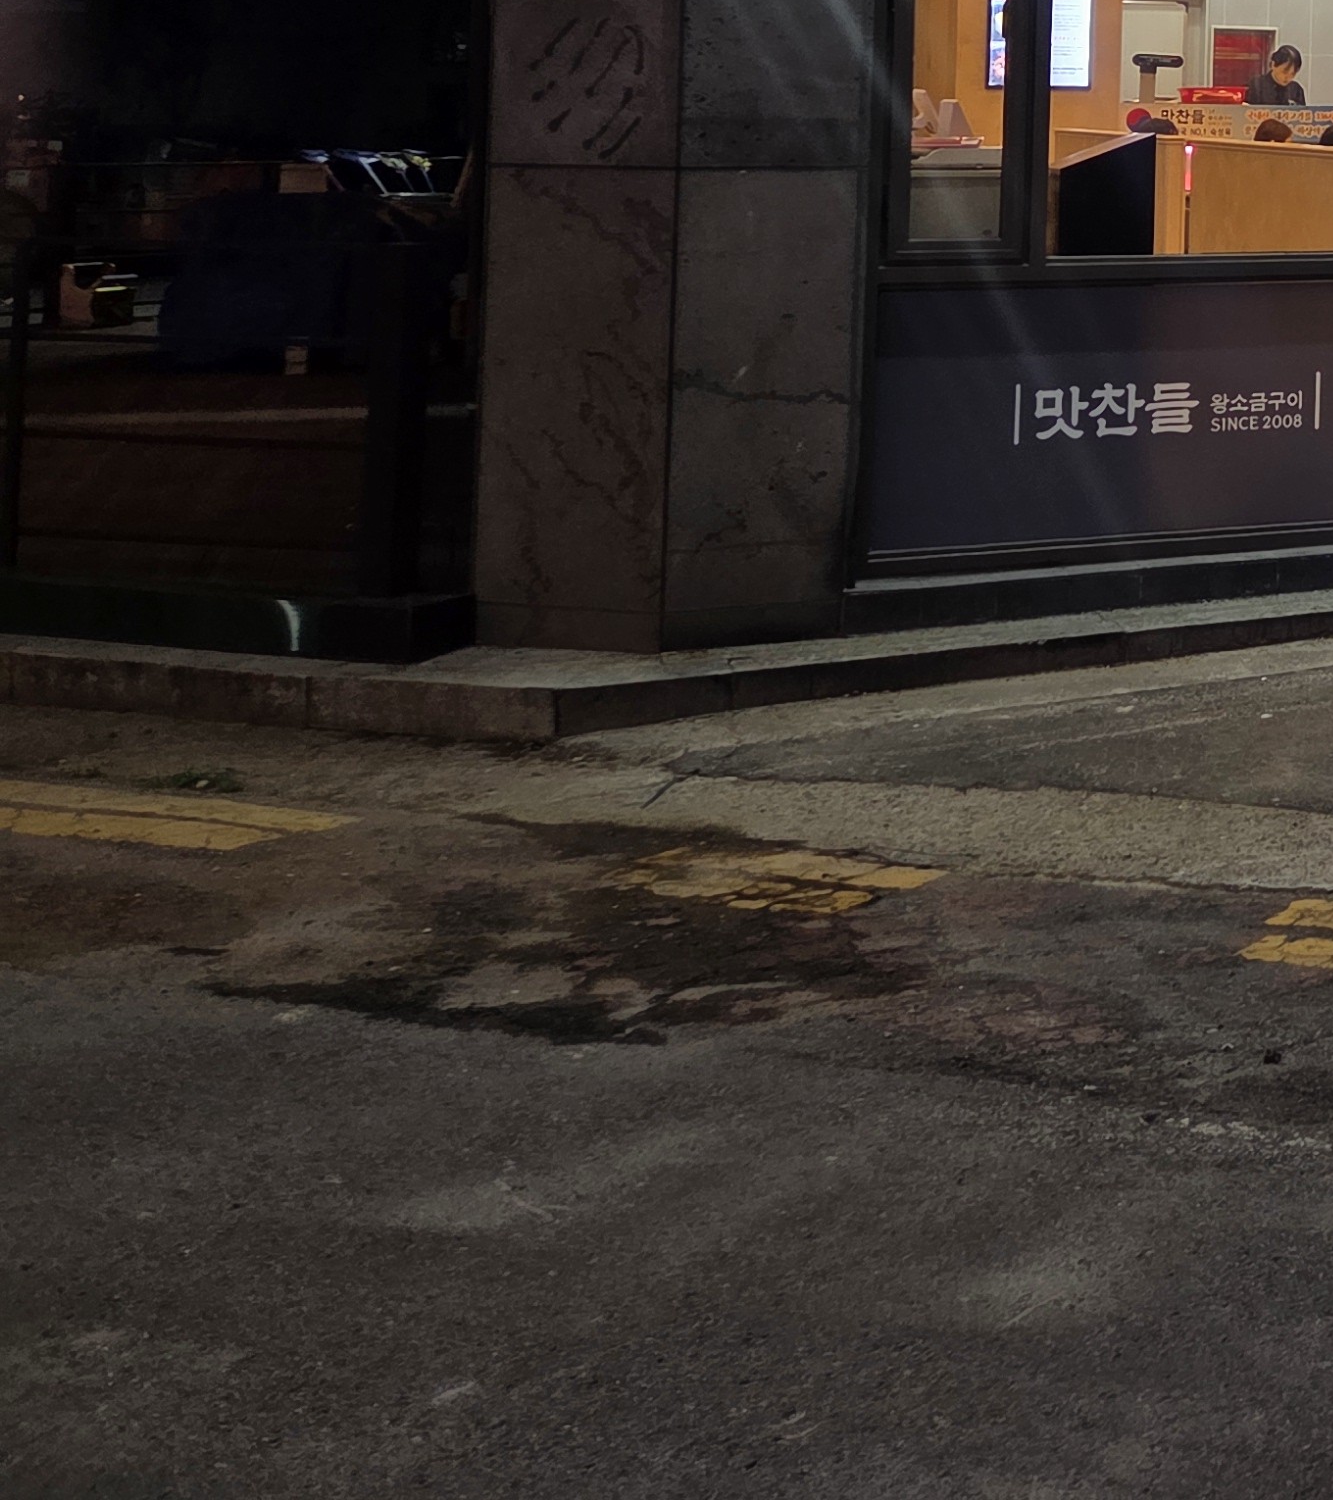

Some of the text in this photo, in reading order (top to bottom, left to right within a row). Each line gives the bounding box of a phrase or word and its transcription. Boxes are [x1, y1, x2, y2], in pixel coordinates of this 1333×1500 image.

[1034, 382, 1303, 441] 맛찬들 왕소금구이
[1210, 413, 1303, 432] SINCE 2008
